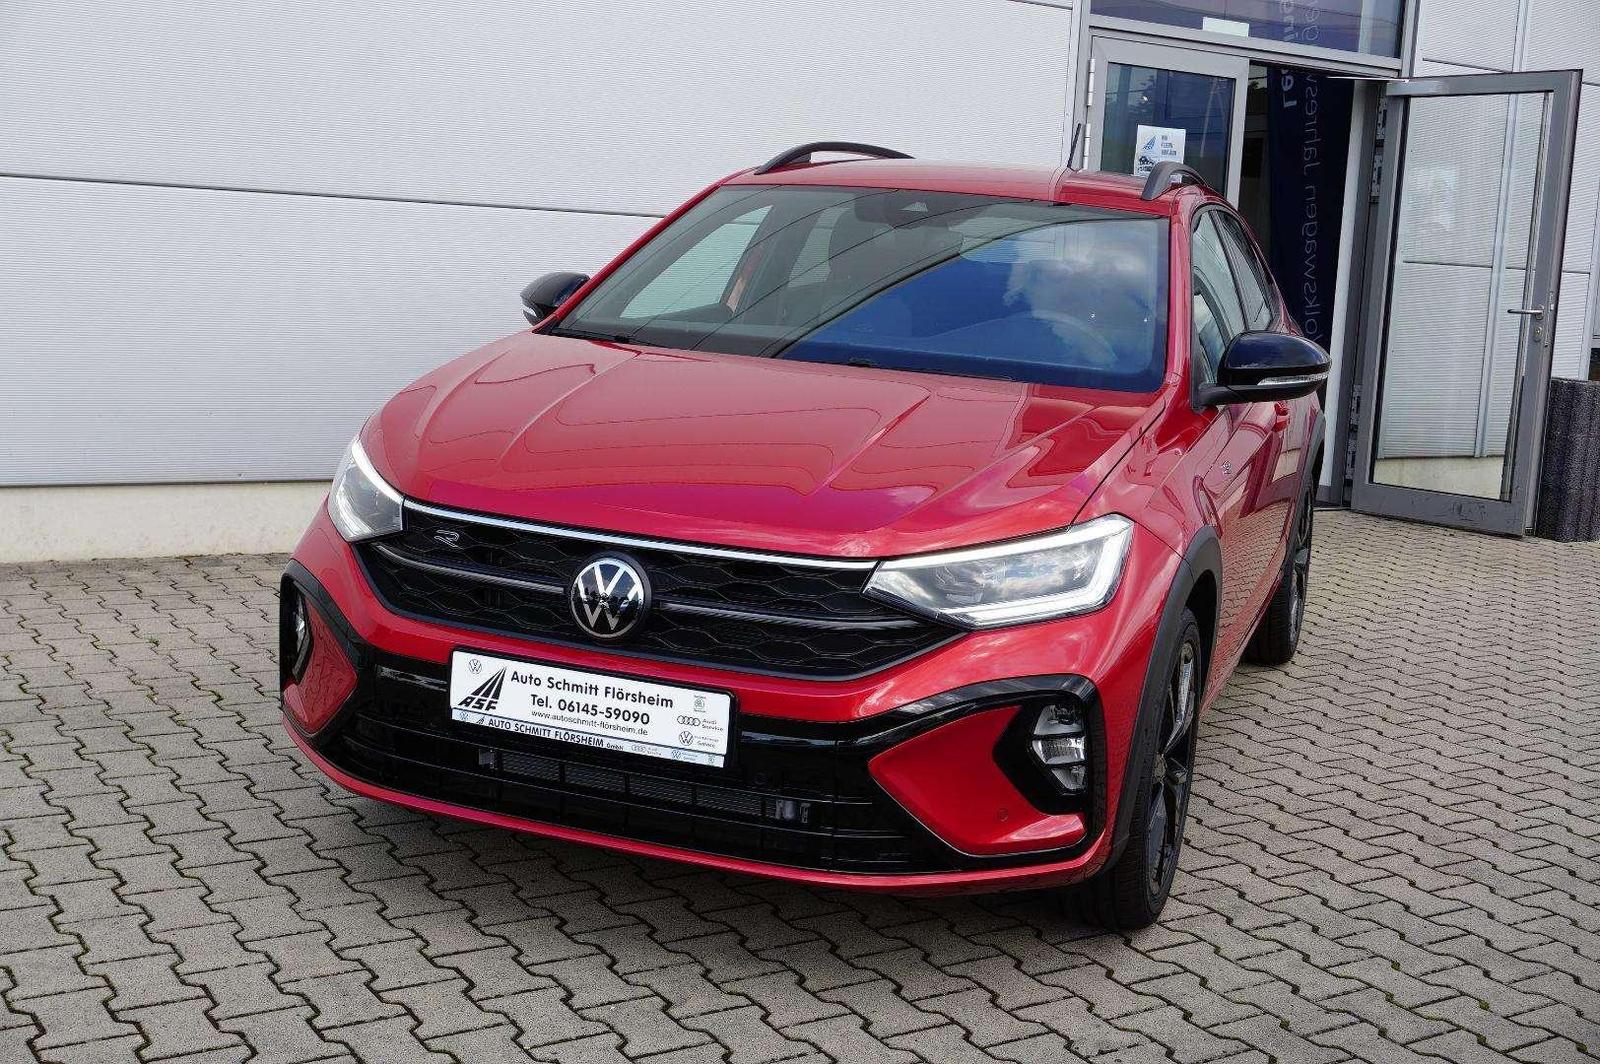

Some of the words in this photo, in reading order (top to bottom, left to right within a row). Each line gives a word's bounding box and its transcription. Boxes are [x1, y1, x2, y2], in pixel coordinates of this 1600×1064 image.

[458, 695, 498, 711] ASF
[510, 670, 542, 687] Auto
[547, 676, 600, 697] Schmitt
[604, 686, 674, 709] Flörsheim
[530, 694, 553, 709] Tel.
[557, 699, 650, 725] 06145-59090
[531, 710, 649, 736] www.autoschmitt-flörsheim.de
[487, 718, 511, 730] AUTO
[514, 723, 551, 738] SCHMITT
[554, 730, 604, 748] FLÖRSHEIM
